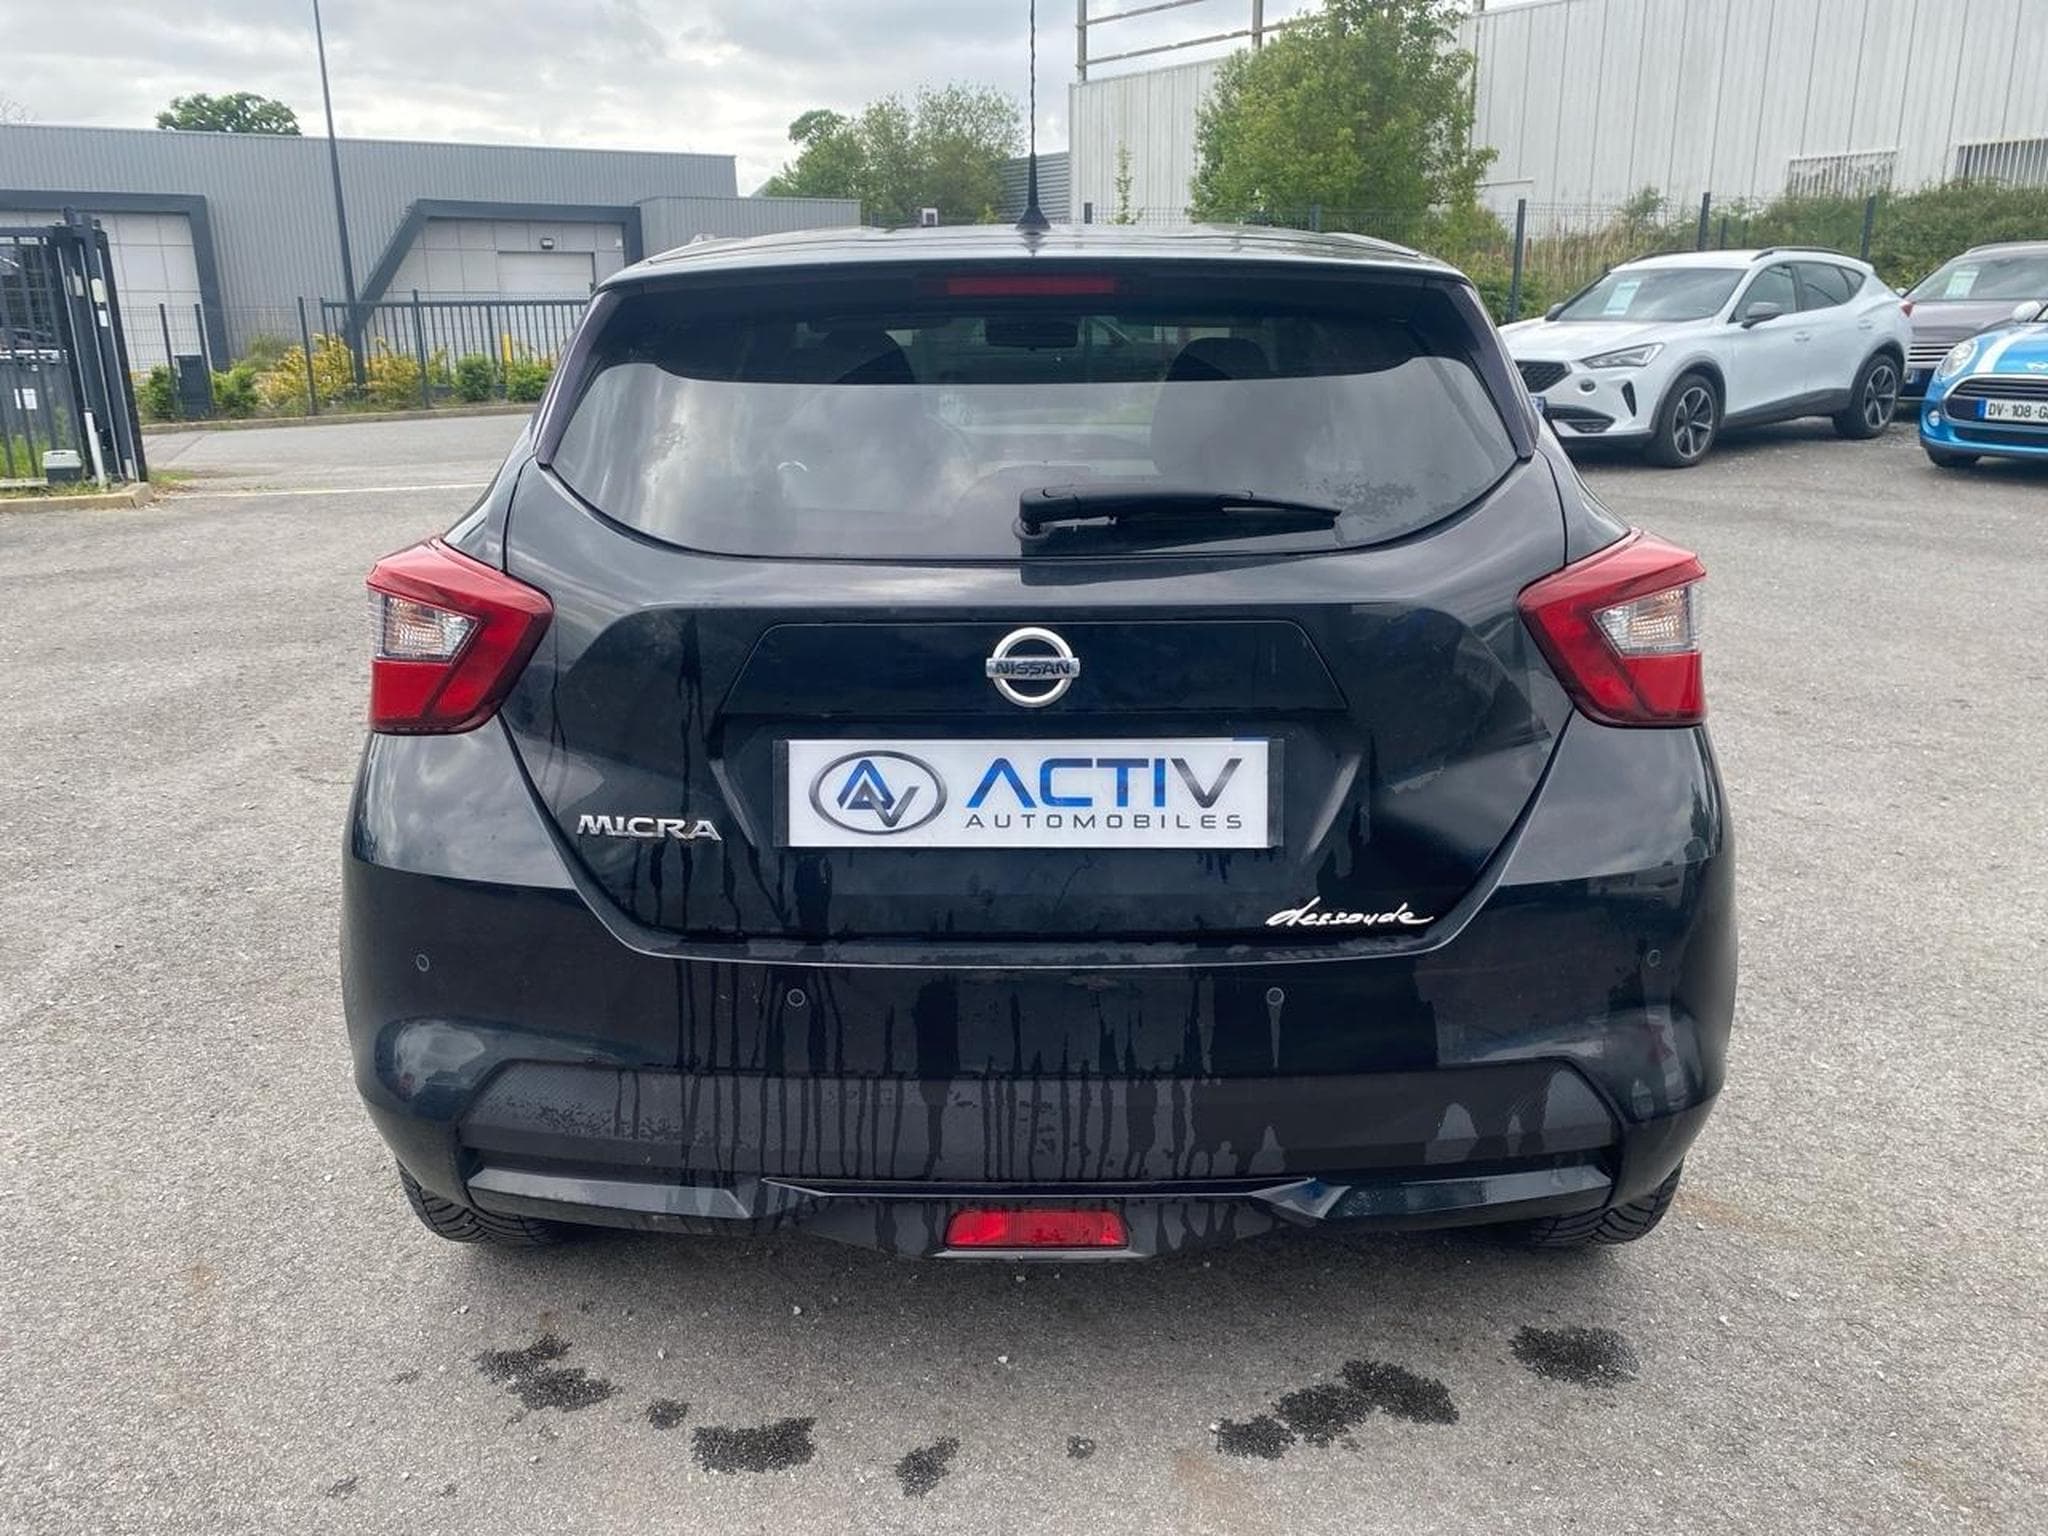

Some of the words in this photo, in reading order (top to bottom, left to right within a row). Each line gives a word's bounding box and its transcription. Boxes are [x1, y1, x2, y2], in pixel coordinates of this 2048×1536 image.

[1988, 402, 2048, 420] DV-108-G
[994, 660, 1070, 675] NISSAN
[966, 757, 1242, 808] ACTIV
[576, 814, 722, 841] MICRA
[965, 813, 1242, 829] AUTOMOBILES
